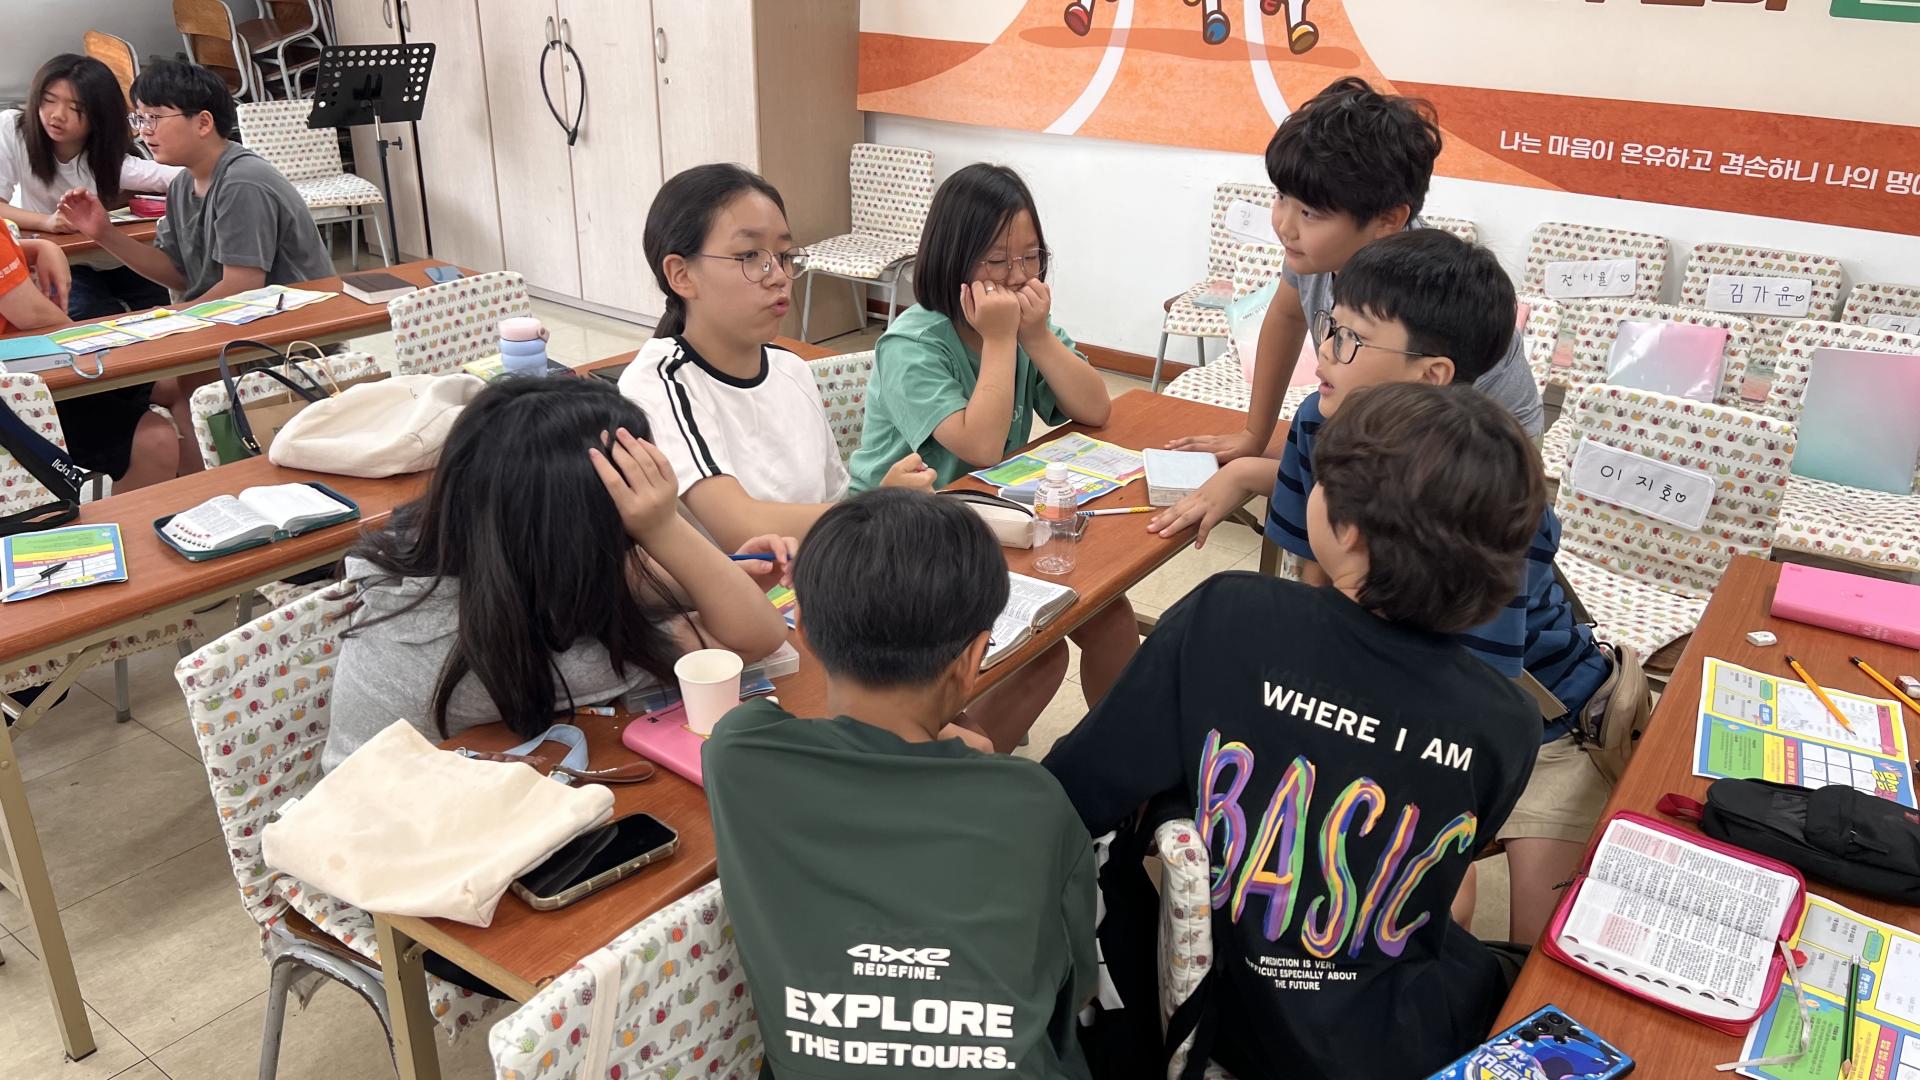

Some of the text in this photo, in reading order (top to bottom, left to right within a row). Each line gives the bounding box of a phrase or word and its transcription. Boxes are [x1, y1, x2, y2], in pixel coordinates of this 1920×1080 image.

[1499, 130, 1542, 154] 나는
[1548, 135, 1615, 160] 마음이
[1620, 142, 1713, 172] 온유하고
[1719, 152, 1820, 183] 겸손하니
[1825, 163, 1880, 190] 나의
[1263, 681, 1473, 771] WHERE I AM
[1195, 728, 1477, 958] BASIC
[853, 962, 941, 980] REDEFINE.
[1260, 956, 1299, 968] PREDICTION
[1303, 960, 1312, 968] IS
[1280, 969, 1324, 979] ESPECIALLY
[1327, 972, 1357, 980] ABOUT
[1275, 979, 1320, 990] THE FUTURE
[784, 986, 1015, 1038] EXPLORE
[785, 1030, 1016, 1070] THE DETOURS.
